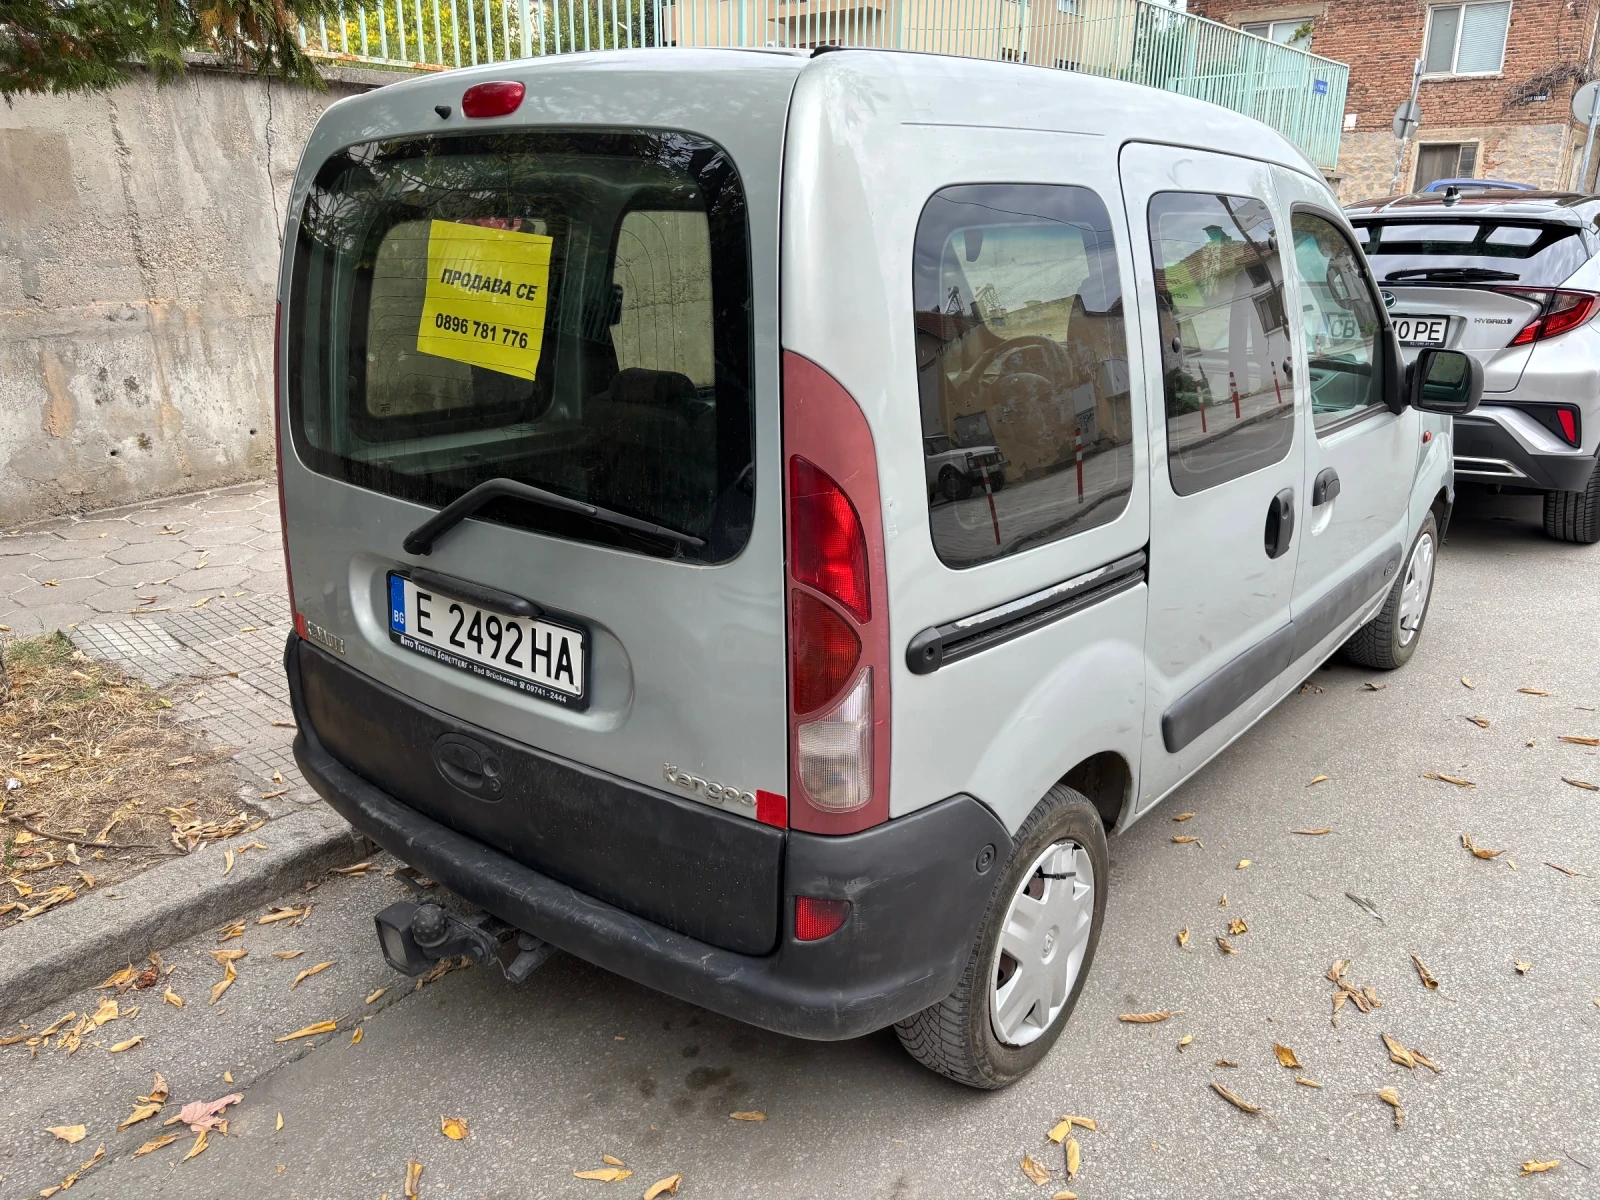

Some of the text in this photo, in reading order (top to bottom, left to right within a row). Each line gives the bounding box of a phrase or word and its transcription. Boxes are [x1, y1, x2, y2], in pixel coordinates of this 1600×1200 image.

[441, 268, 538, 301] ПРОДАВА СЕ
[435, 313, 529, 348] 0896 781 776
[1413, 321, 1443, 341] PE
[394, 610, 405, 624] BG
[416, 591, 434, 637] E
[474, 665, 485, 675] Bad
[663, 762, 757, 808] Kangoo
